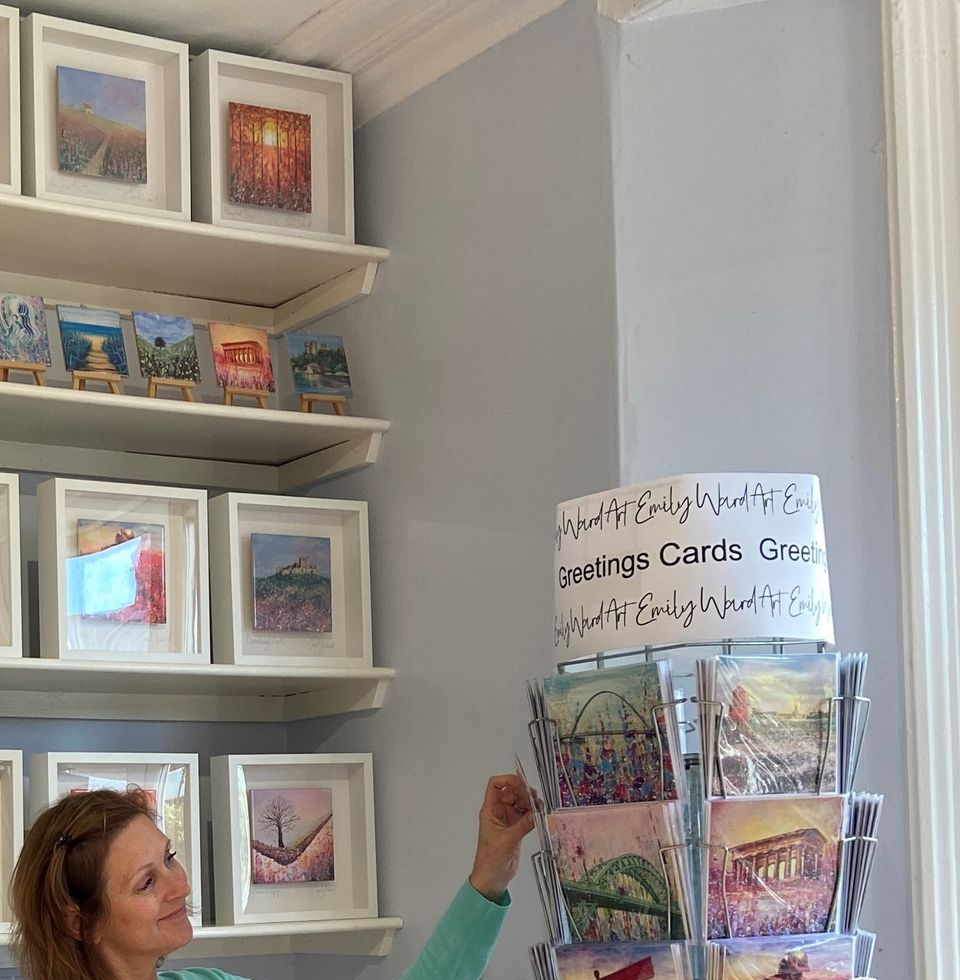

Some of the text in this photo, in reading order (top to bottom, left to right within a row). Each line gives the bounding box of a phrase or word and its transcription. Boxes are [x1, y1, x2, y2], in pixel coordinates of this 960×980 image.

[562, 501, 604, 540] Ward
[604, 498, 637, 530] Art
[635, 486, 693, 525] Emily
[695, 482, 749, 517] Ward
[749, 482, 783, 515] Art
[558, 550, 650, 589] Greetings
[659, 538, 743, 567] Cards
[569, 600, 604, 638] Ward
[604, 598, 637, 631] Art
[635, 592, 698, 628] Emily
[700, 584, 758, 620] Ward
[758, 584, 789, 618] Art
